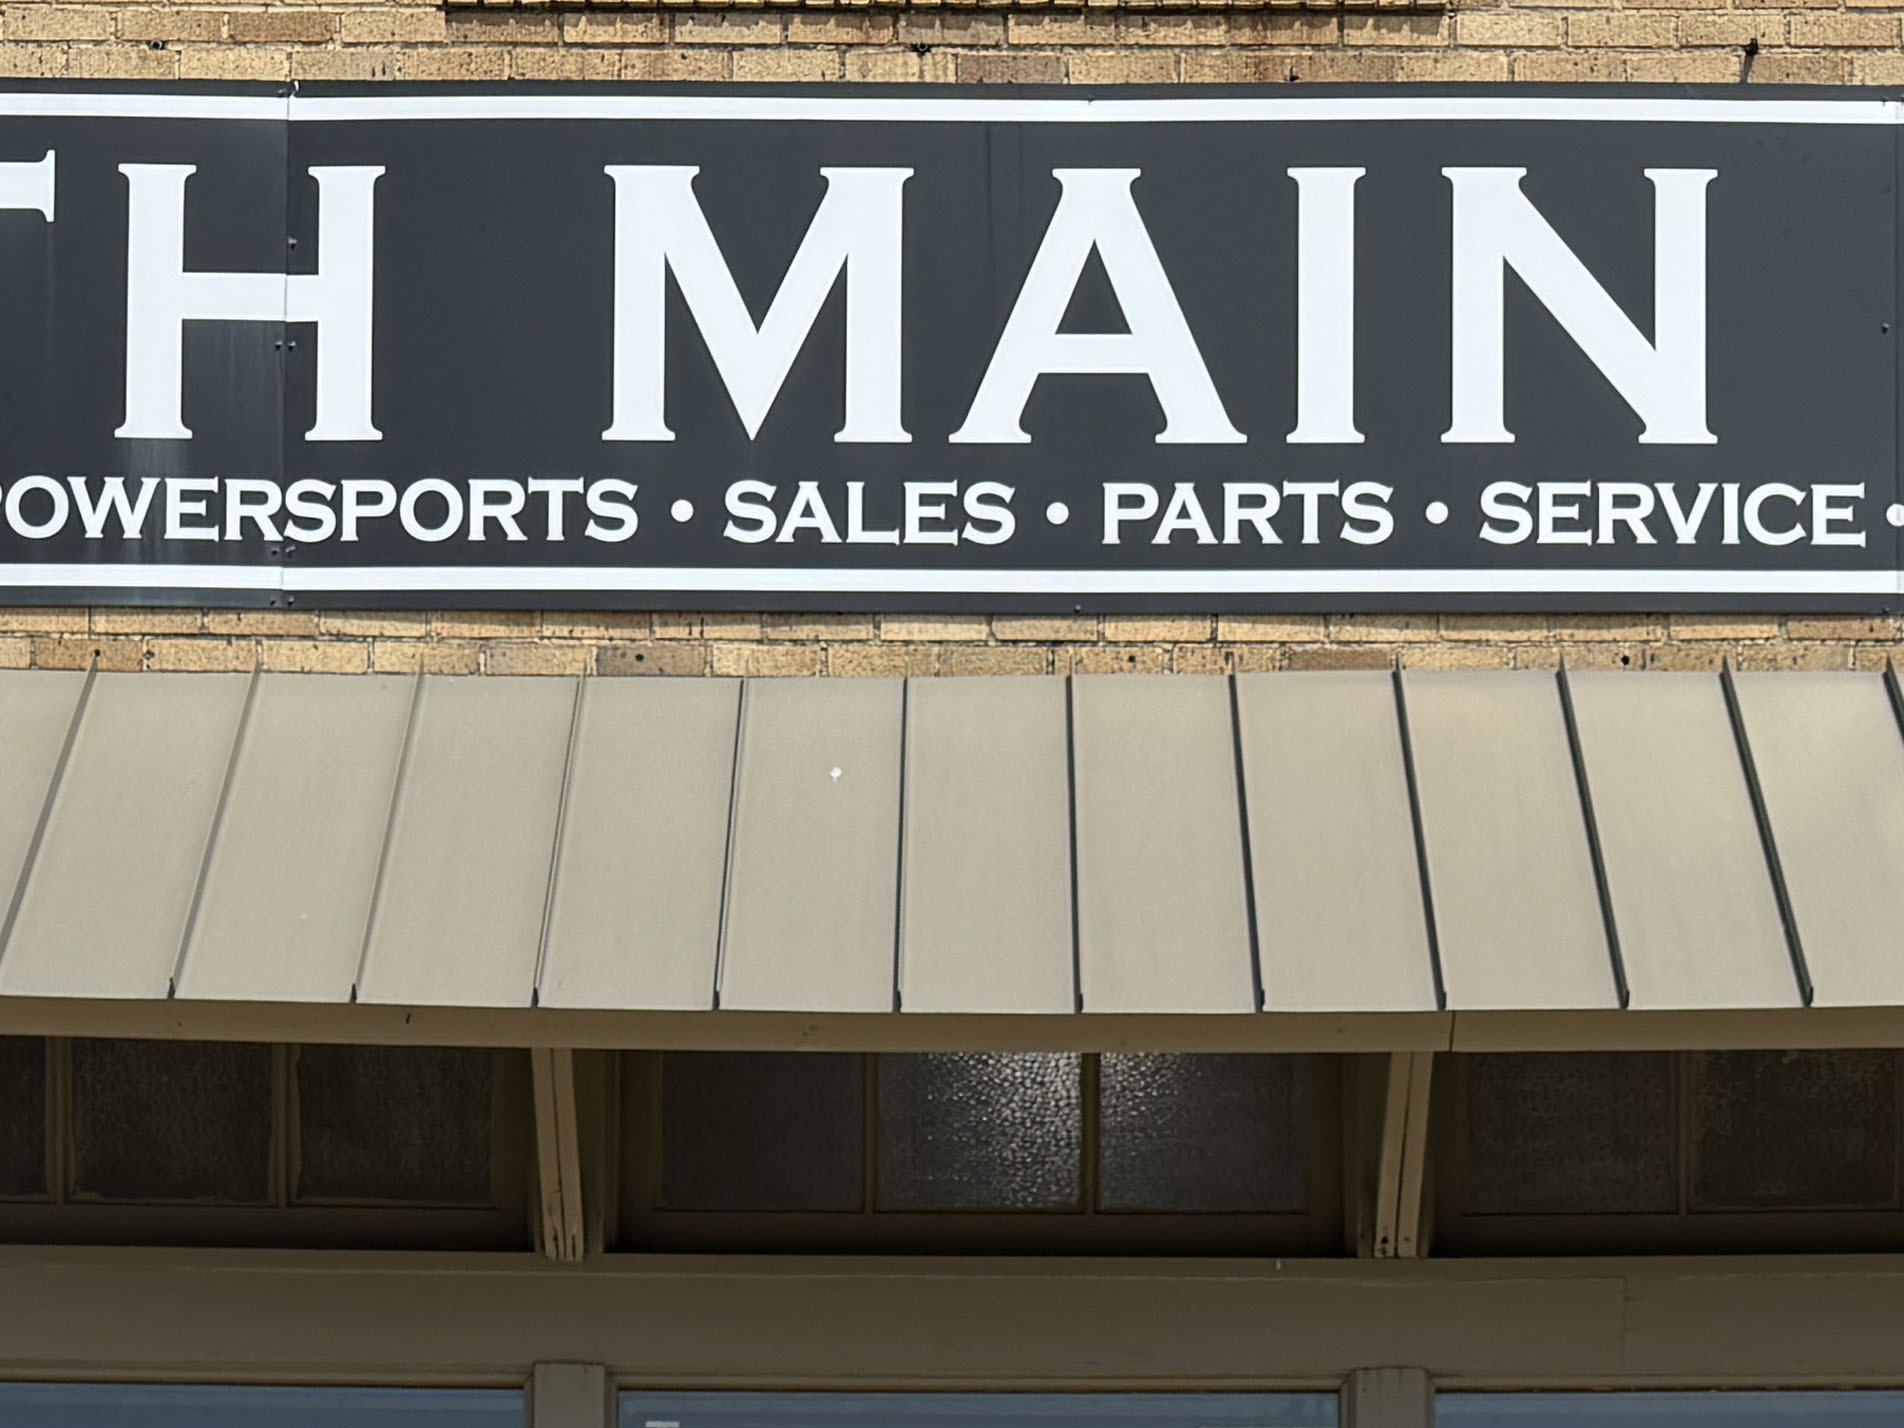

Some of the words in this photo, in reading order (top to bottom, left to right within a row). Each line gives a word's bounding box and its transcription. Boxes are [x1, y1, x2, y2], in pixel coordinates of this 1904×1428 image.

[602, 165, 1716, 442] MAIN
[722, 478, 1016, 546] SALES
[1101, 479, 1394, 545] PARTS
[1478, 479, 1866, 548] SERVICE
